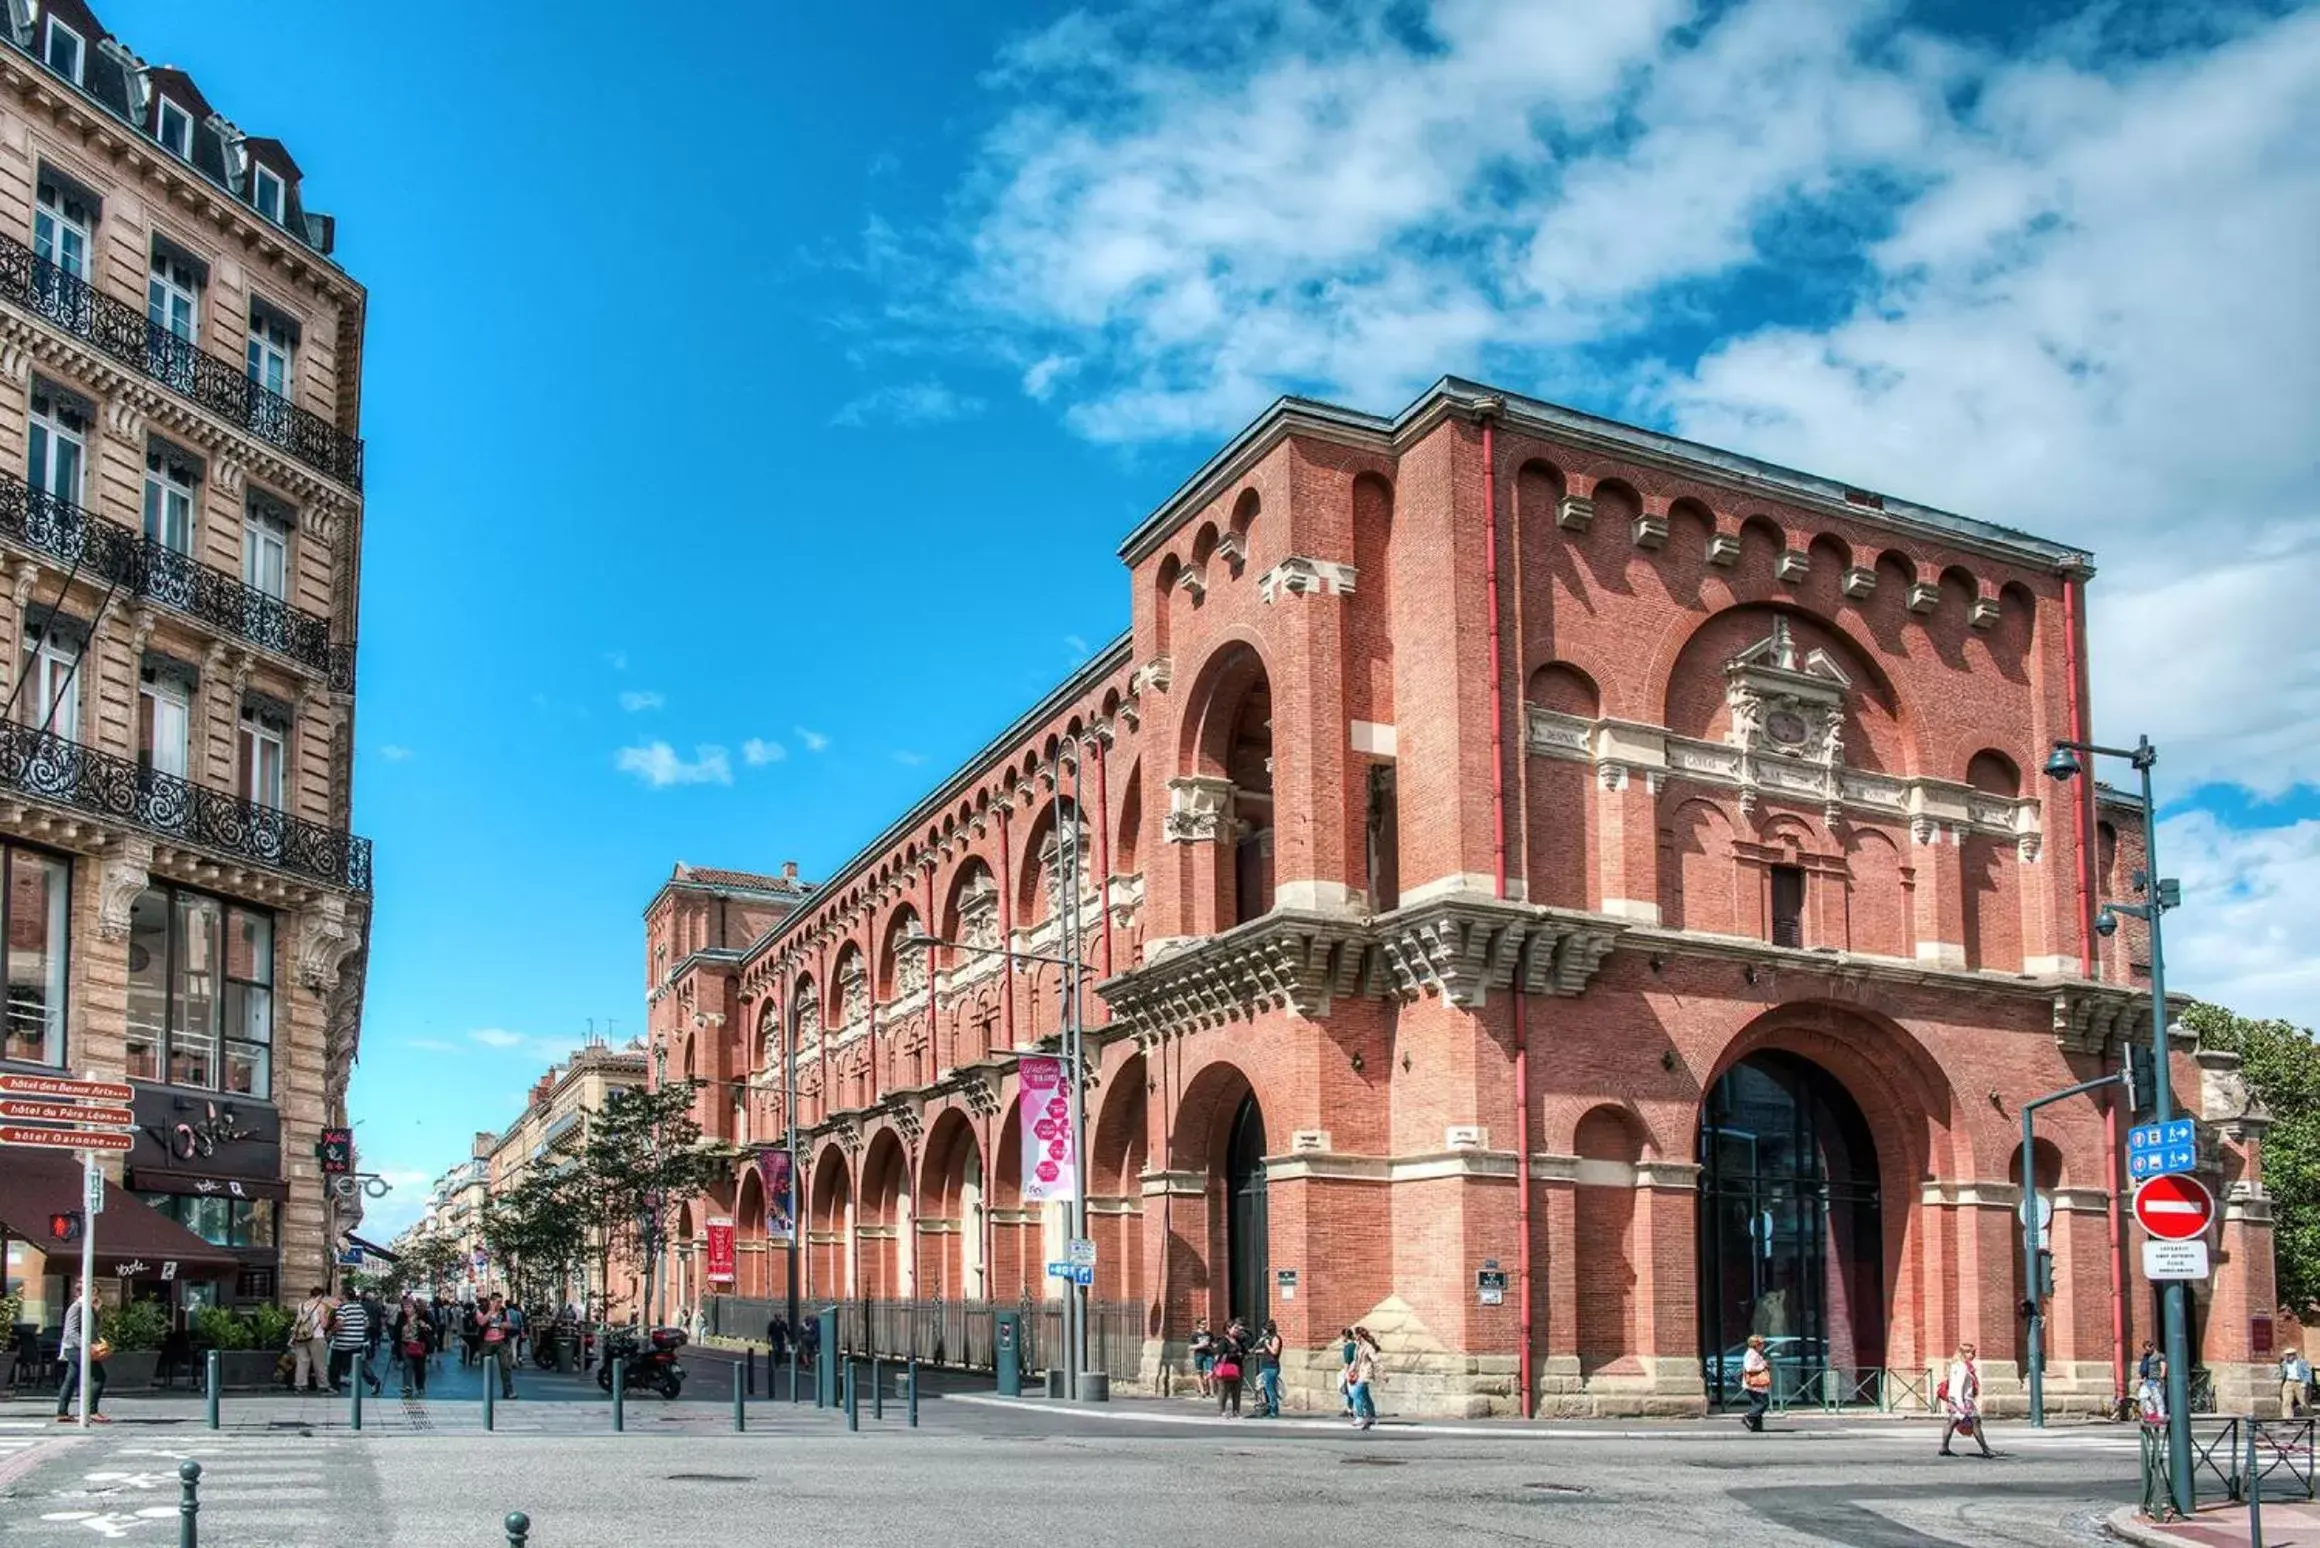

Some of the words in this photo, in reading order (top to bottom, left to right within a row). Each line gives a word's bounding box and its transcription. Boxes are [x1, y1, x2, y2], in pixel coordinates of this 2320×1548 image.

[10, 1079, 37, 1090] hôtel
[39, 1080, 57, 1091] des
[58, 1082, 90, 1094] Beaux
[10, 1104, 40, 1115] hôtel
[42, 1107, 57, 1117] du
[59, 1107, 84, 1118] Père
[14, 1130, 47, 1142] hôtel
